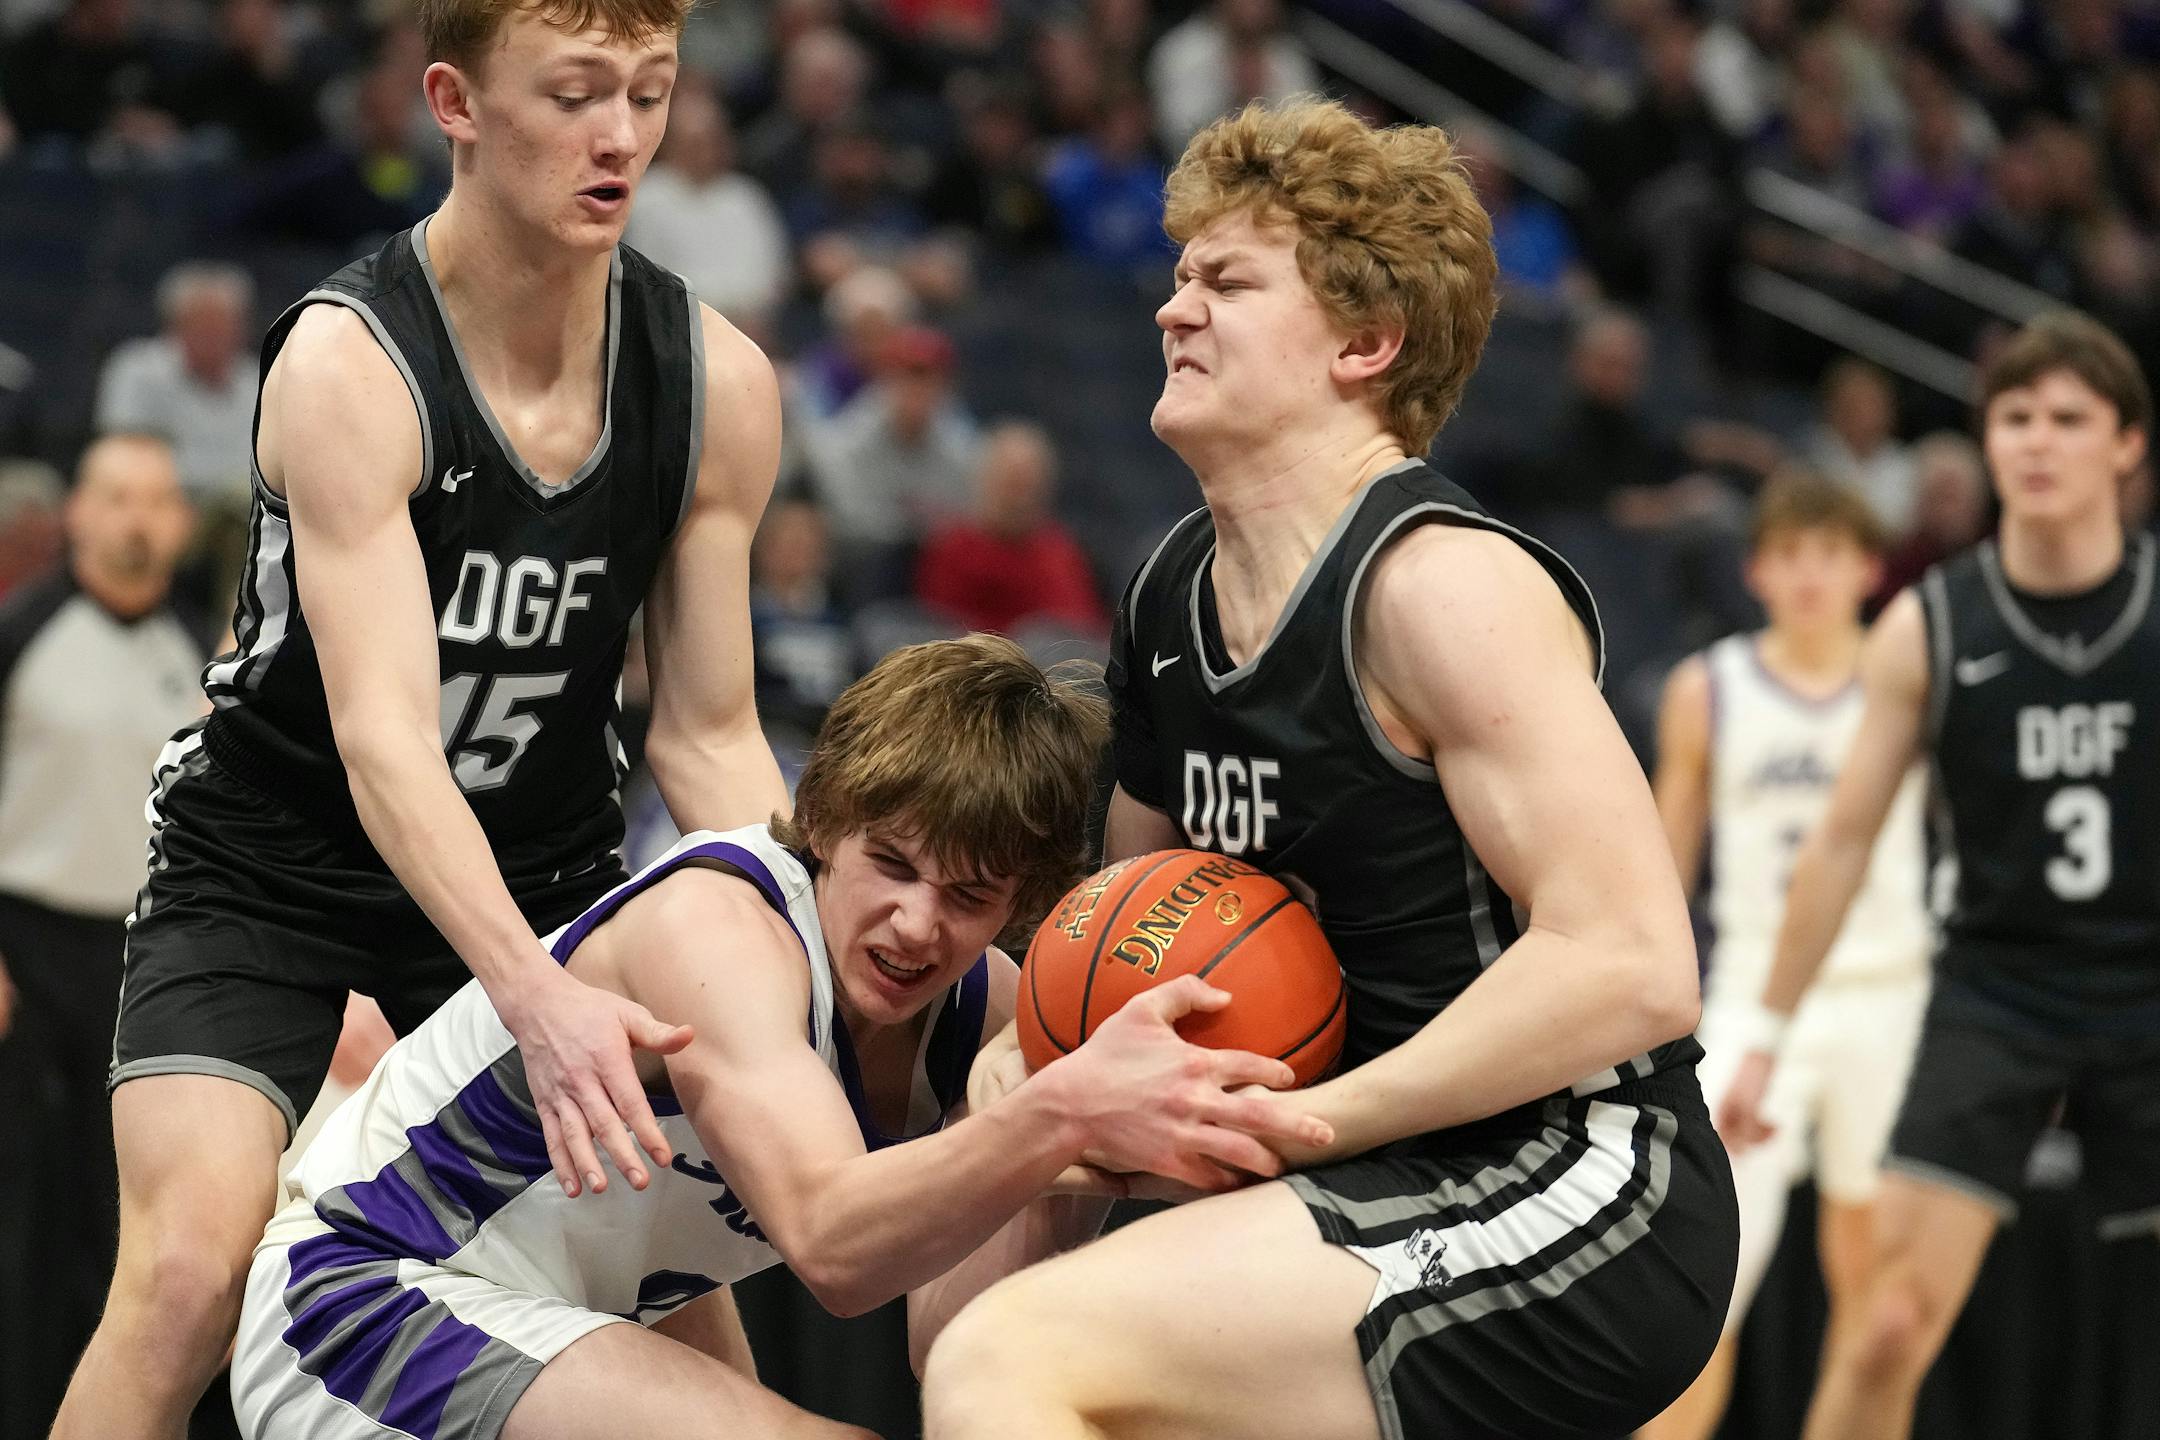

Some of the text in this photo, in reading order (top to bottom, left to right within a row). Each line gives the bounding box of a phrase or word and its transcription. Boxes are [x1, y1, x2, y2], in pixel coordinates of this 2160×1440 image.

[438, 549, 608, 649] DGF
[2016, 702, 2136, 782] DGF
[1182, 749, 1281, 856] DGF
[2044, 785, 2113, 899] 3
[1112, 857, 1266, 977] PALDING
